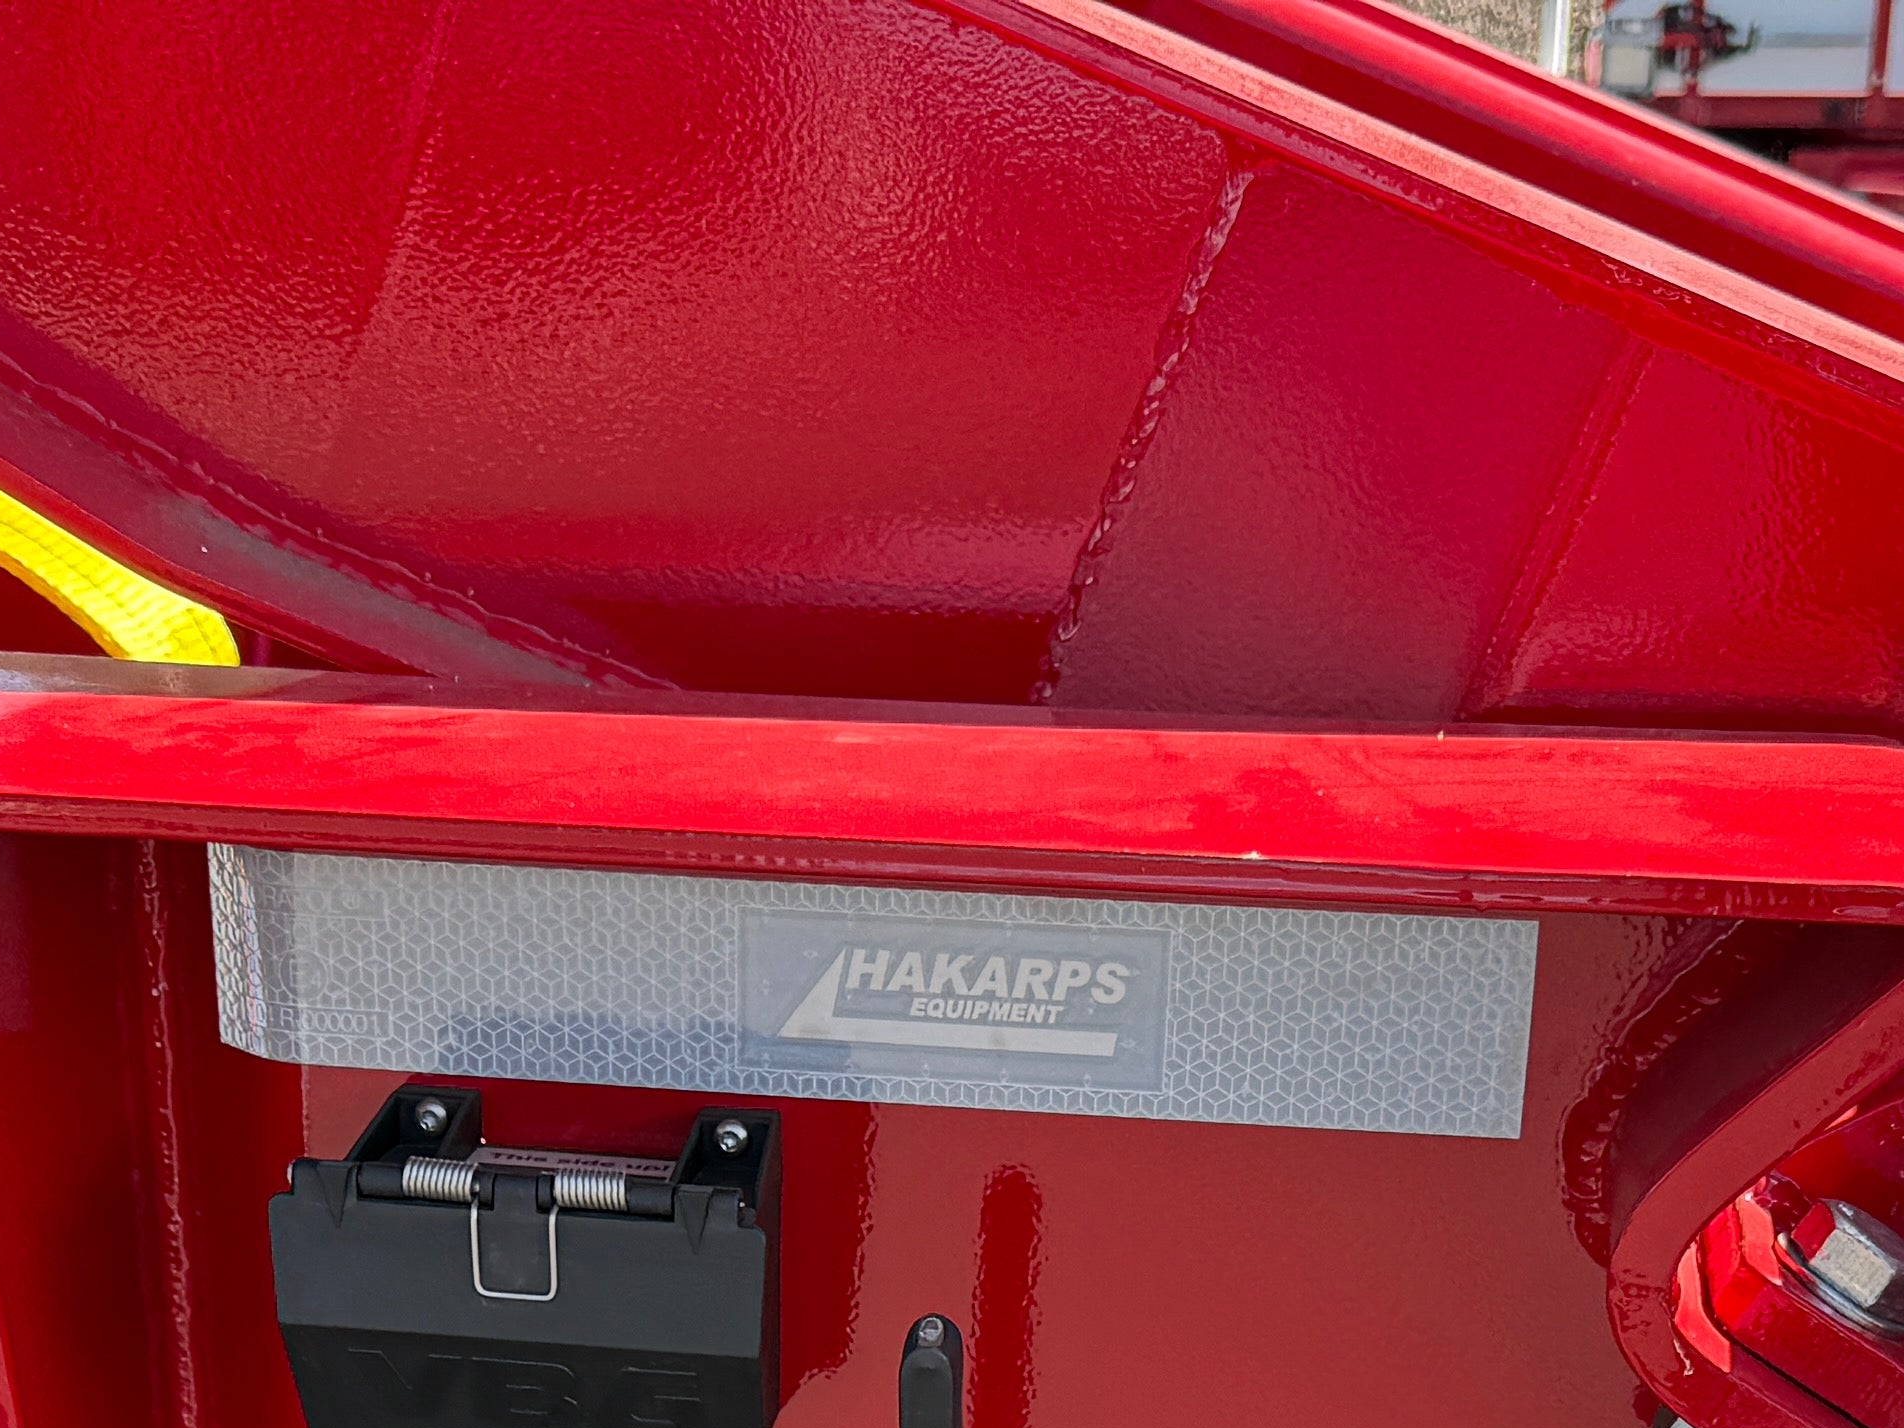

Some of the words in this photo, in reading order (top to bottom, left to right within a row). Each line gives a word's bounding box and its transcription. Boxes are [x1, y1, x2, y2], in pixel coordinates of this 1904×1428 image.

[845, 947, 1131, 1005] HAKARPS
[908, 996, 1064, 1025] EQUIPMENT
[492, 1151, 547, 1163] This
[557, 1157, 616, 1168] side
